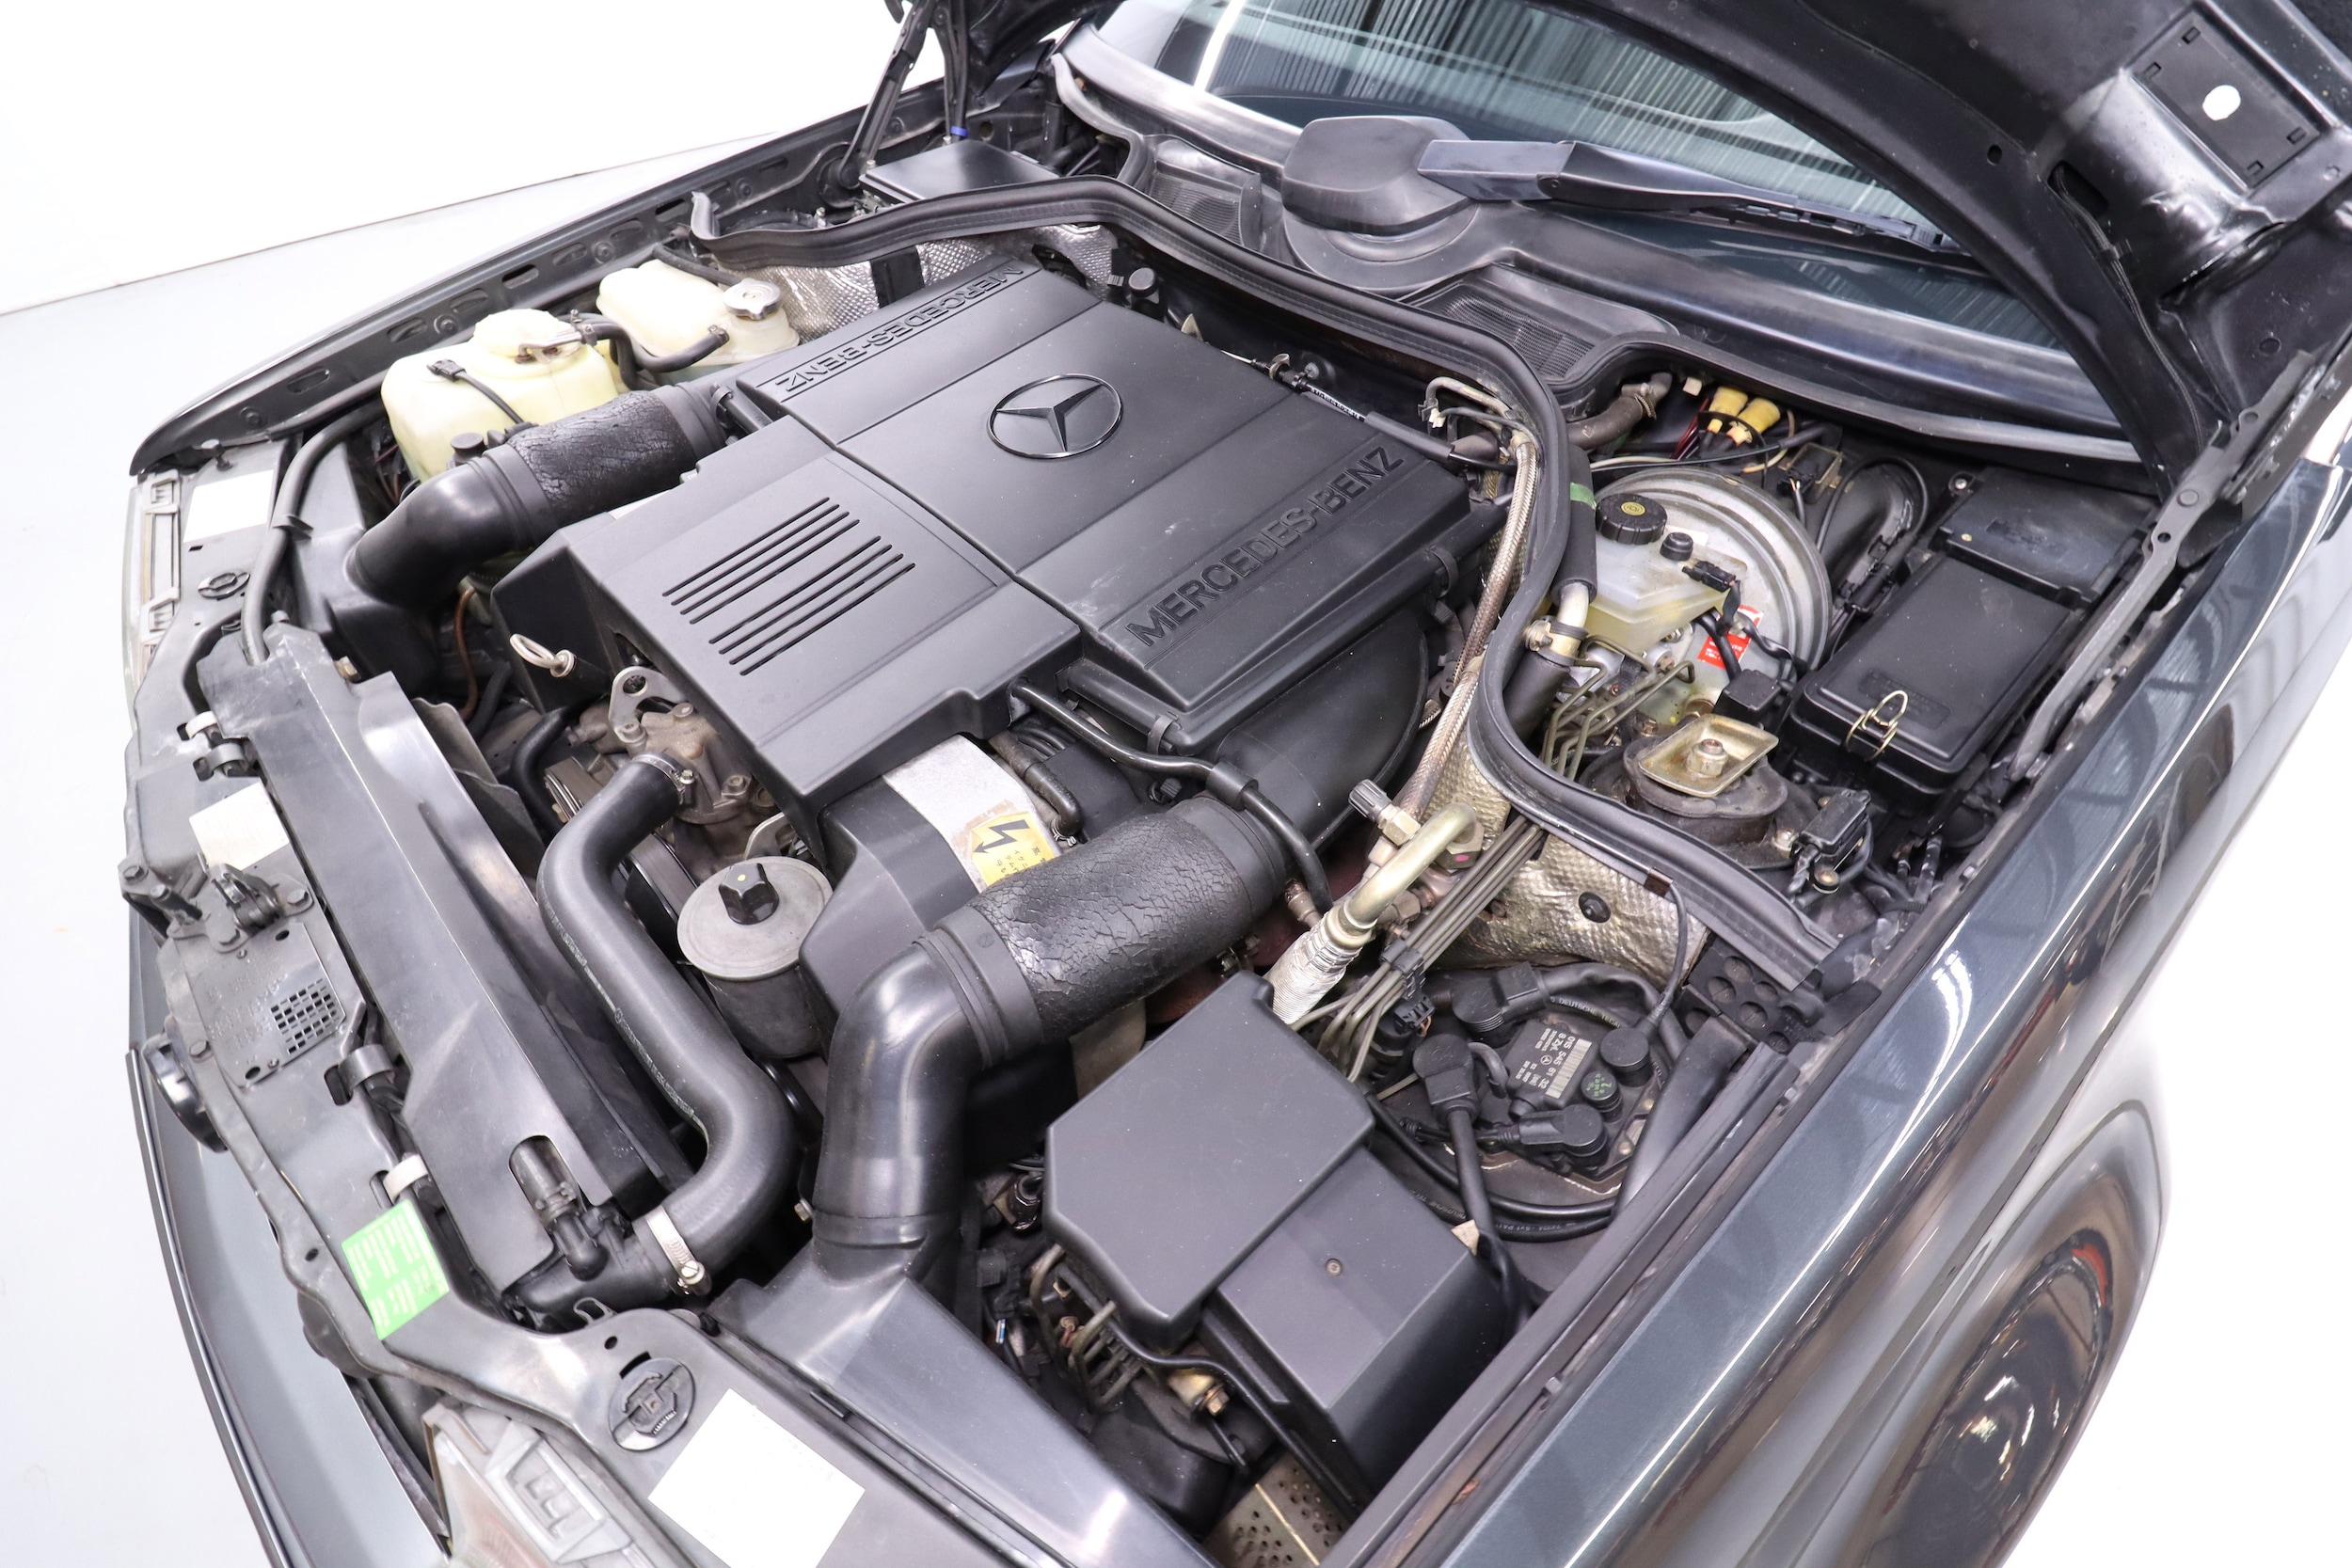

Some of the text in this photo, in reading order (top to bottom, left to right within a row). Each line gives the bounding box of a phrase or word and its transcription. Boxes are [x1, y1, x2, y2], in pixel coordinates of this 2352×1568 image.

[775, 266, 1025, 392] MERCEDES-BENZ
[1125, 446, 1405, 647] MERCEDES-BENZ
[1537, 1036, 1576, 1090] 015 545 61 32
